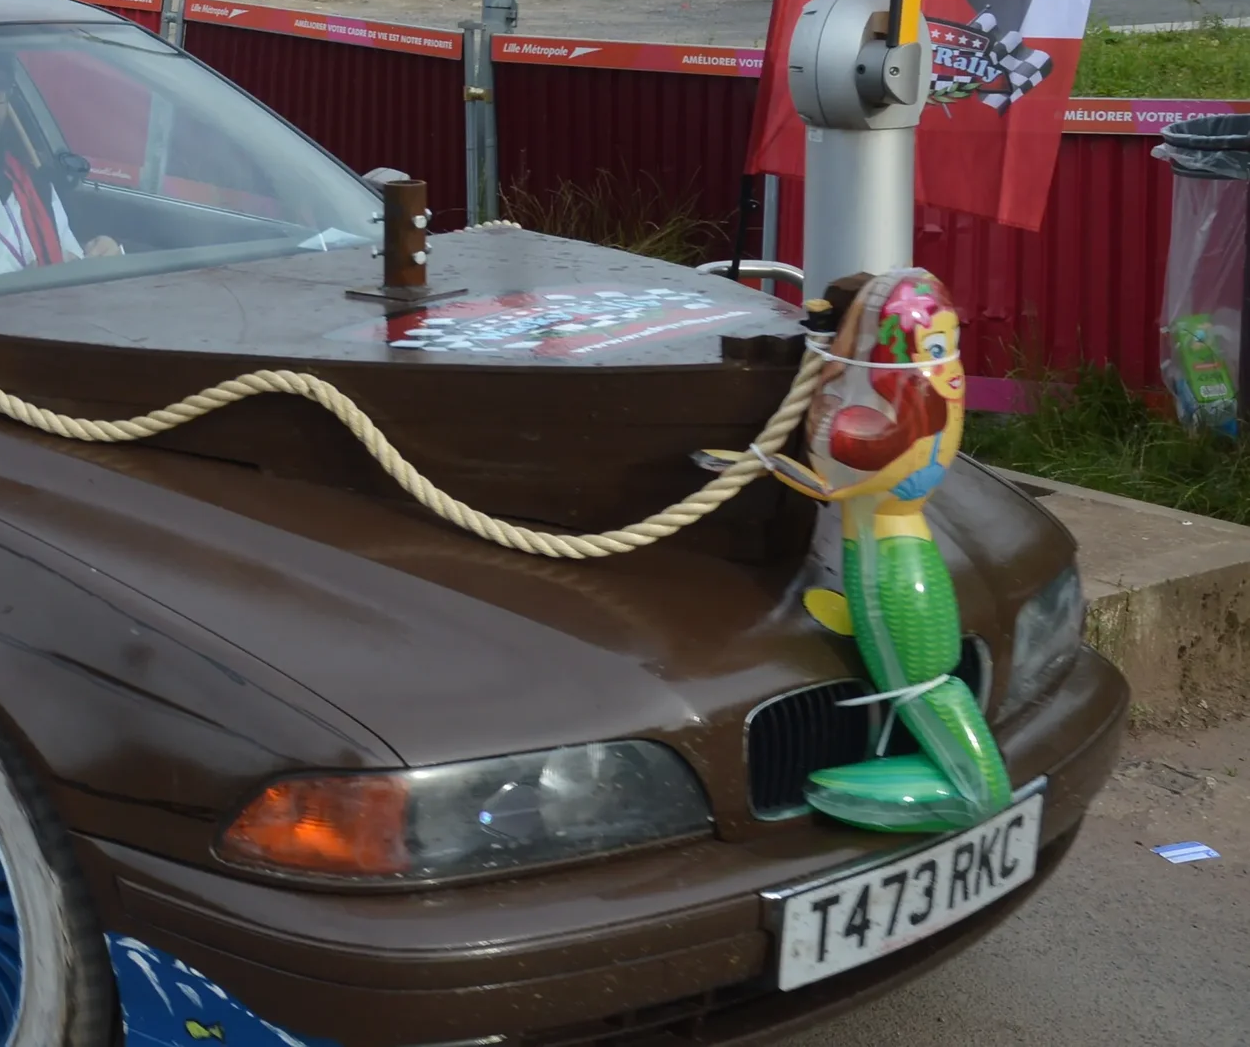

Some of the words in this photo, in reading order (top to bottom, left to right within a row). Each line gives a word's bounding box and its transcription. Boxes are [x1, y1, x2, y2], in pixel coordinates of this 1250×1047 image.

[191, 3, 201, 14] Lille
[294, 17, 326, 31] AMÉLIORER
[327, 24, 347, 34] VOTRE
[347, 26, 367, 37] CADRE
[368, 29, 377, 38] DE
[377, 30, 388, 41] VIE
[389, 32, 400, 42] EST
[400, 34, 423, 45] NOTRE
[423, 36, 453, 50] PRIORITÉ
[503, 42, 521, 54] Lille
[521, 44, 569, 58] Métropole
[681, 52, 737, 67] AMÉLIORER
[933, 46, 1003, 83] Rally
[1063, 107, 1133, 122] MÉLIORER
[1136, 111, 1183, 123] VOTRE
[811, 857, 938, 963] T473
[946, 814, 1025, 910] RKC
